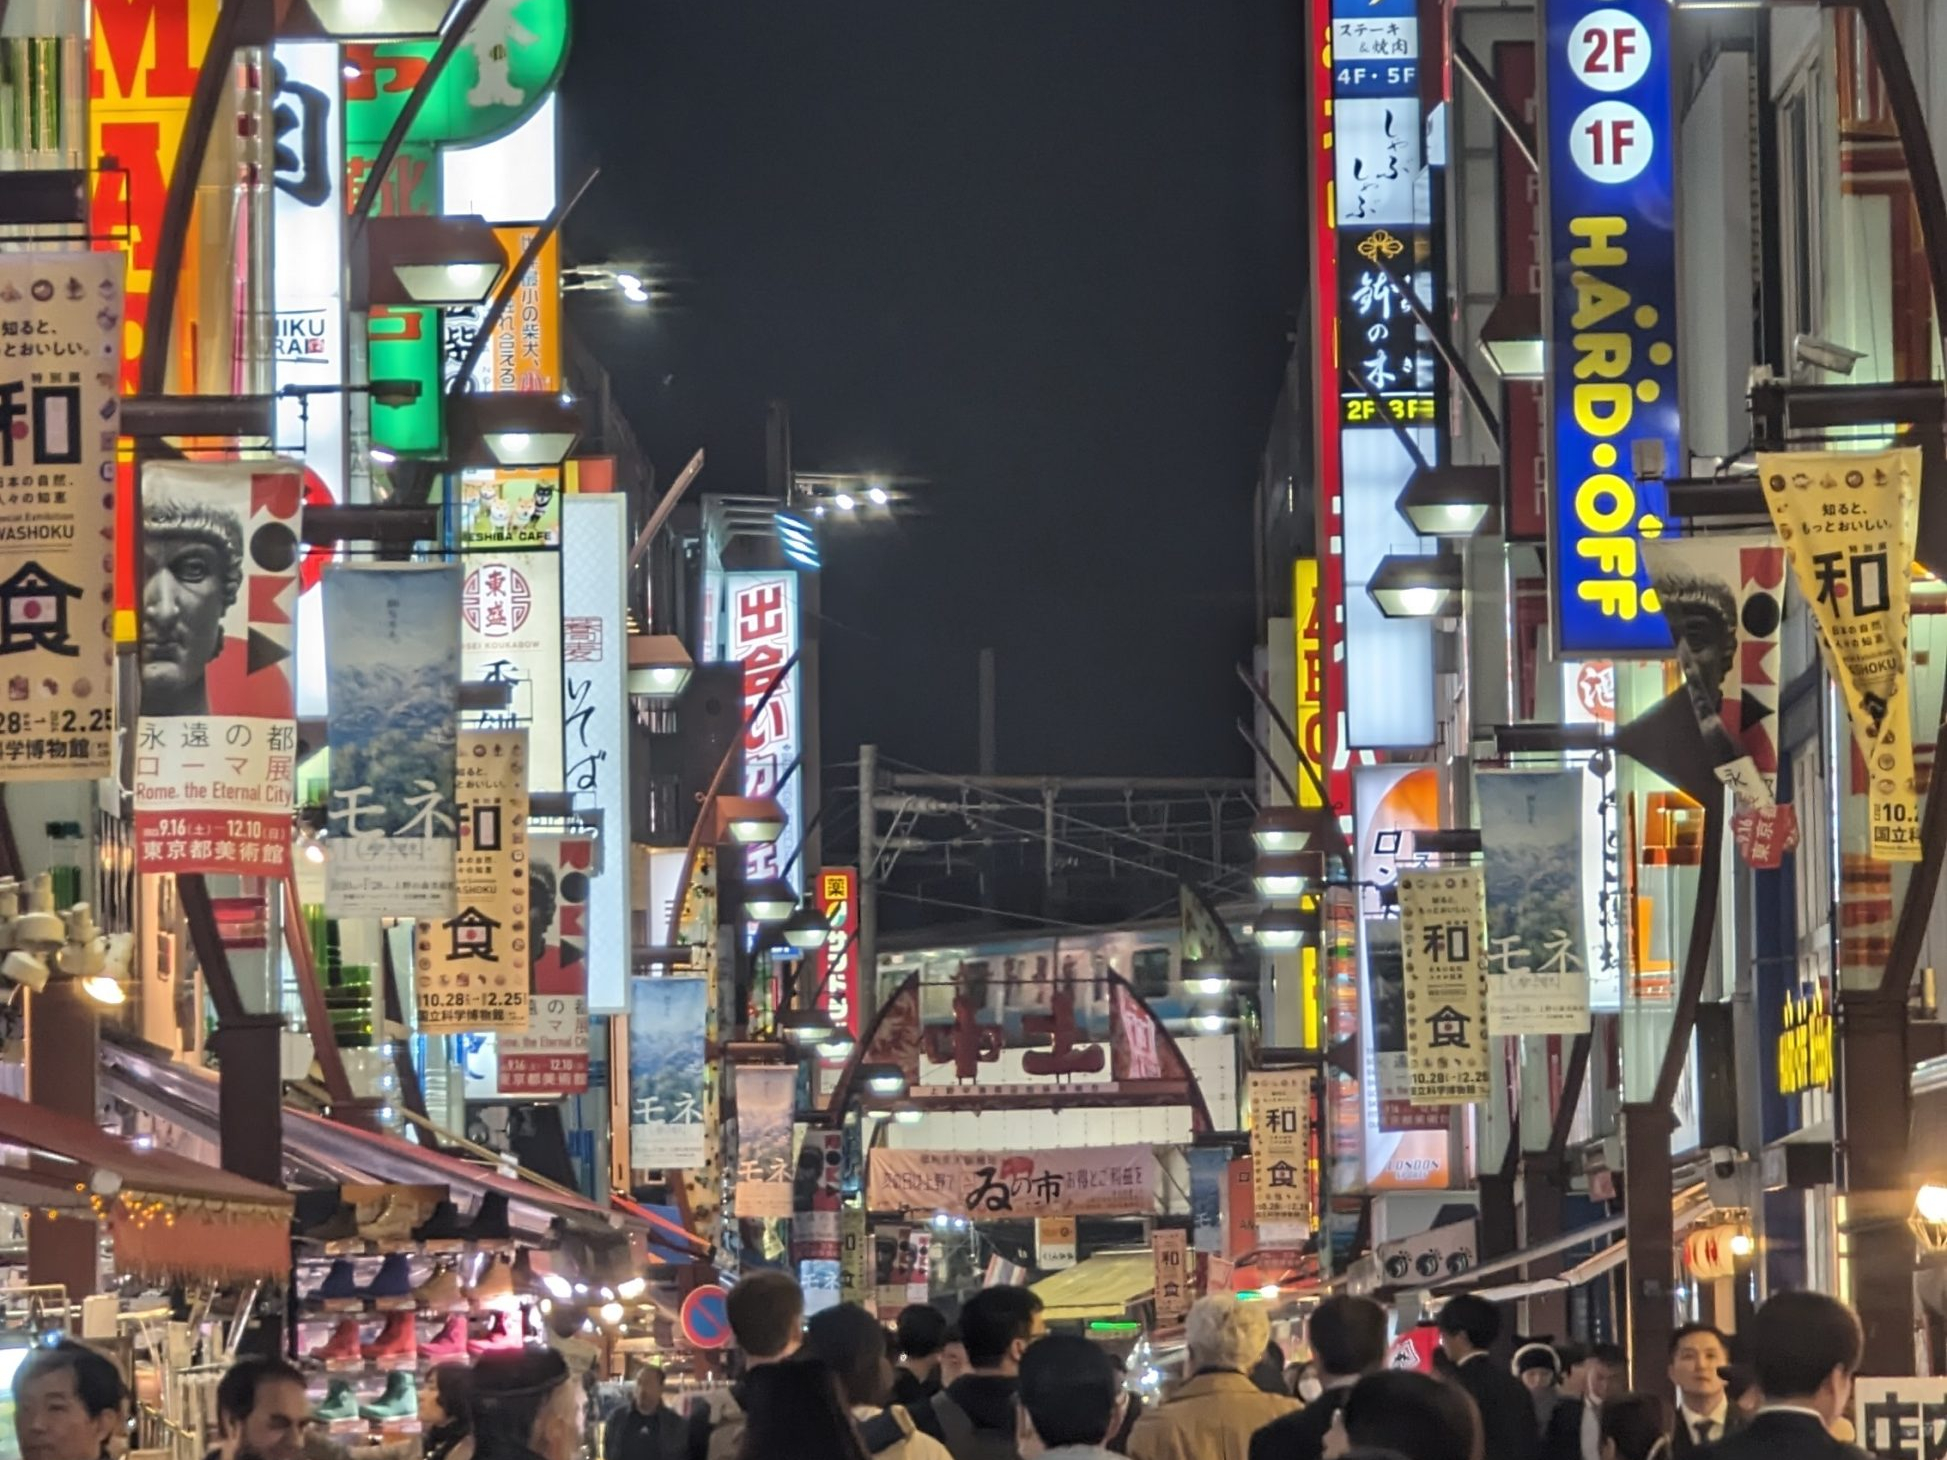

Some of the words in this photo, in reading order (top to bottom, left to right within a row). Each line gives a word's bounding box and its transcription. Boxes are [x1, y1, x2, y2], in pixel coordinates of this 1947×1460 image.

[1340, 23, 1400, 37] ステーキ
[1583, 27, 1636, 73] 2F
[1376, 108, 1413, 180] しゃぶ
[1585, 120, 1634, 165] 1F
[1345, 158, 1379, 219] しゃぶ
[2, 320, 57, 335] 知ると、
[4, 342, 90, 357] とおいしい。
[1347, 400, 1375, 420] 2F
[1389, 400, 1418, 419] 3F
[1822, 503, 1868, 516] 知ると、
[519, 531, 551, 541] CAFE
[1812, 550, 1890, 618] 和
[0, 561, 84, 657] 食
[484, 570, 508, 627] 東盛
[0, 737, 90, 760] 学博物館
[139, 722, 294, 751] 永遠の都
[136, 755, 292, 782] ローマ展
[185, 782, 207, 798] the
[212, 781, 261, 800] Eternal
[265, 784, 292, 807] City
[328, 779, 457, 839] モネ
[142, 840, 285, 864] 東京都美術館
[442, 906, 502, 962] 食
[1423, 924, 1470, 962] 和
[1487, 929, 1584, 974] モネ
[423, 993, 465, 1007] 10.28
[488, 991, 523, 1007] 2.25
[1425, 1005, 1471, 1049] 食
[633, 1092, 703, 1124] モネ
[1265, 1109, 1297, 1133] 和
[737, 1157, 794, 1183] モネ
[1266, 1160, 1297, 1188] 食
